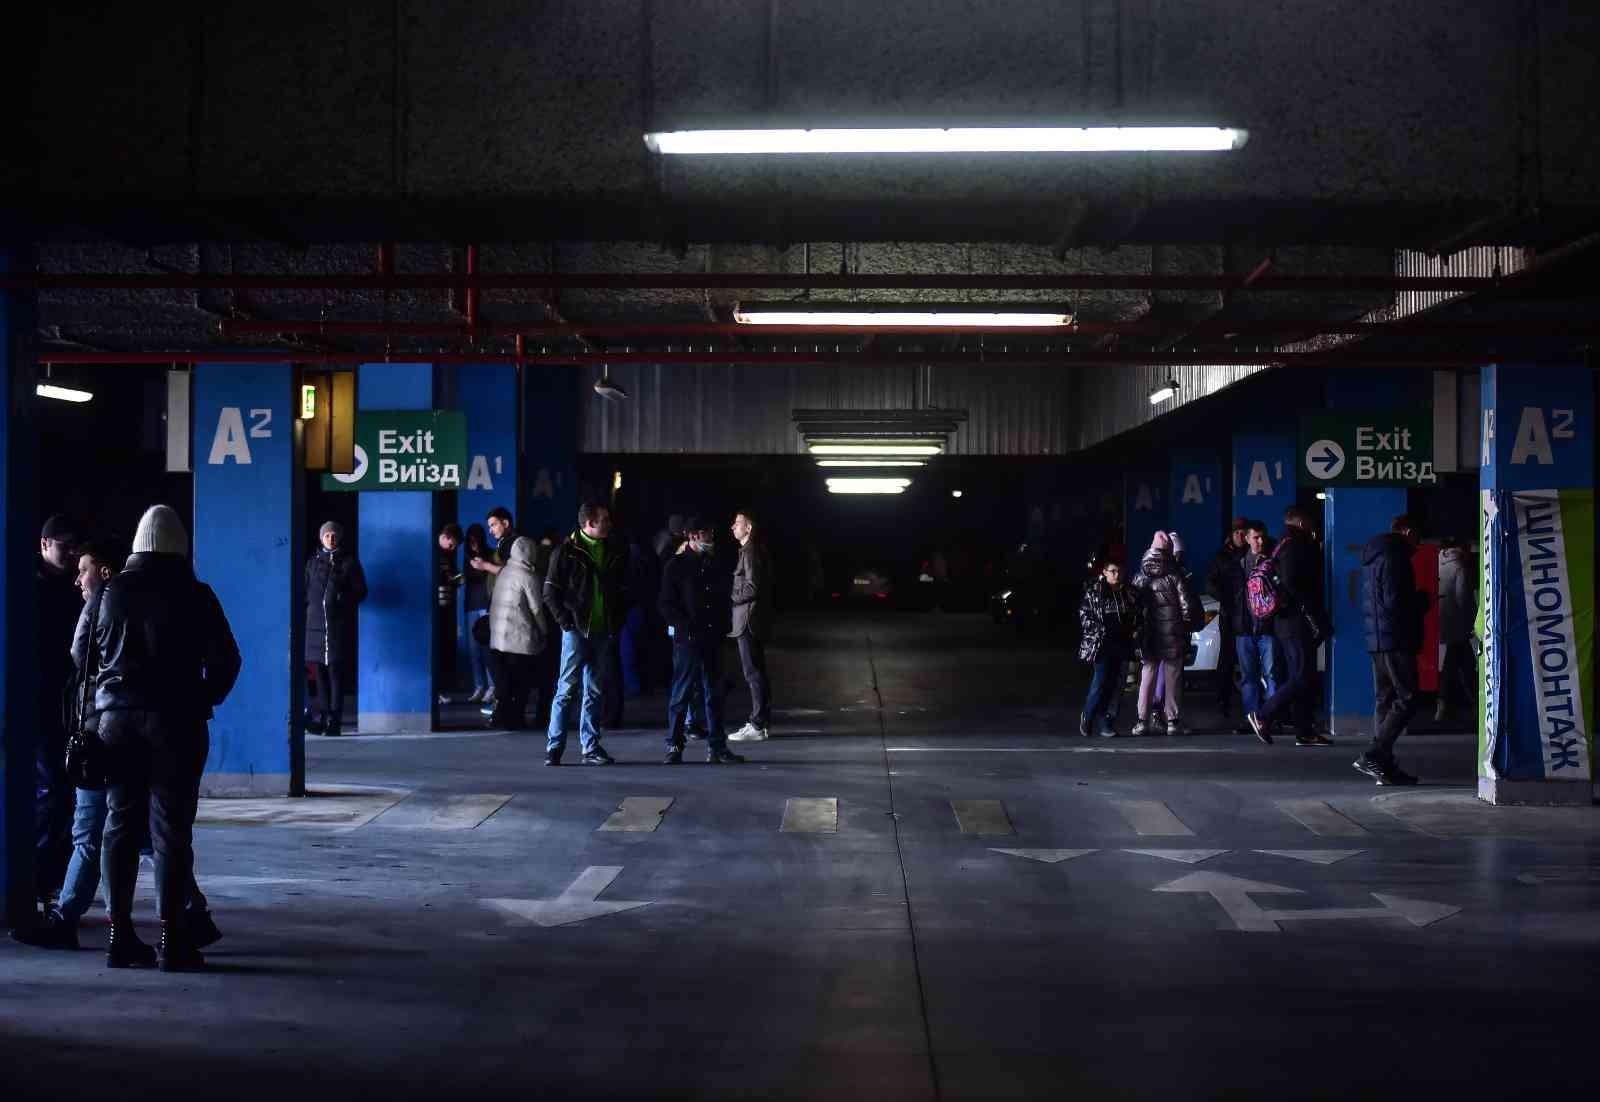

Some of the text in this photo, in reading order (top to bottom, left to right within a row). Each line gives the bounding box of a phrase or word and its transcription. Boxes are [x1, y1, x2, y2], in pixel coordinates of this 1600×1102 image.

[379, 429, 435, 454] Exit
[1356, 425, 1412, 450] Exit
[379, 458, 460, 487] Виїзд
[1356, 455, 1437, 484] Виїзд
[1525, 502, 1580, 770] ШИНОМОНТАЖ
